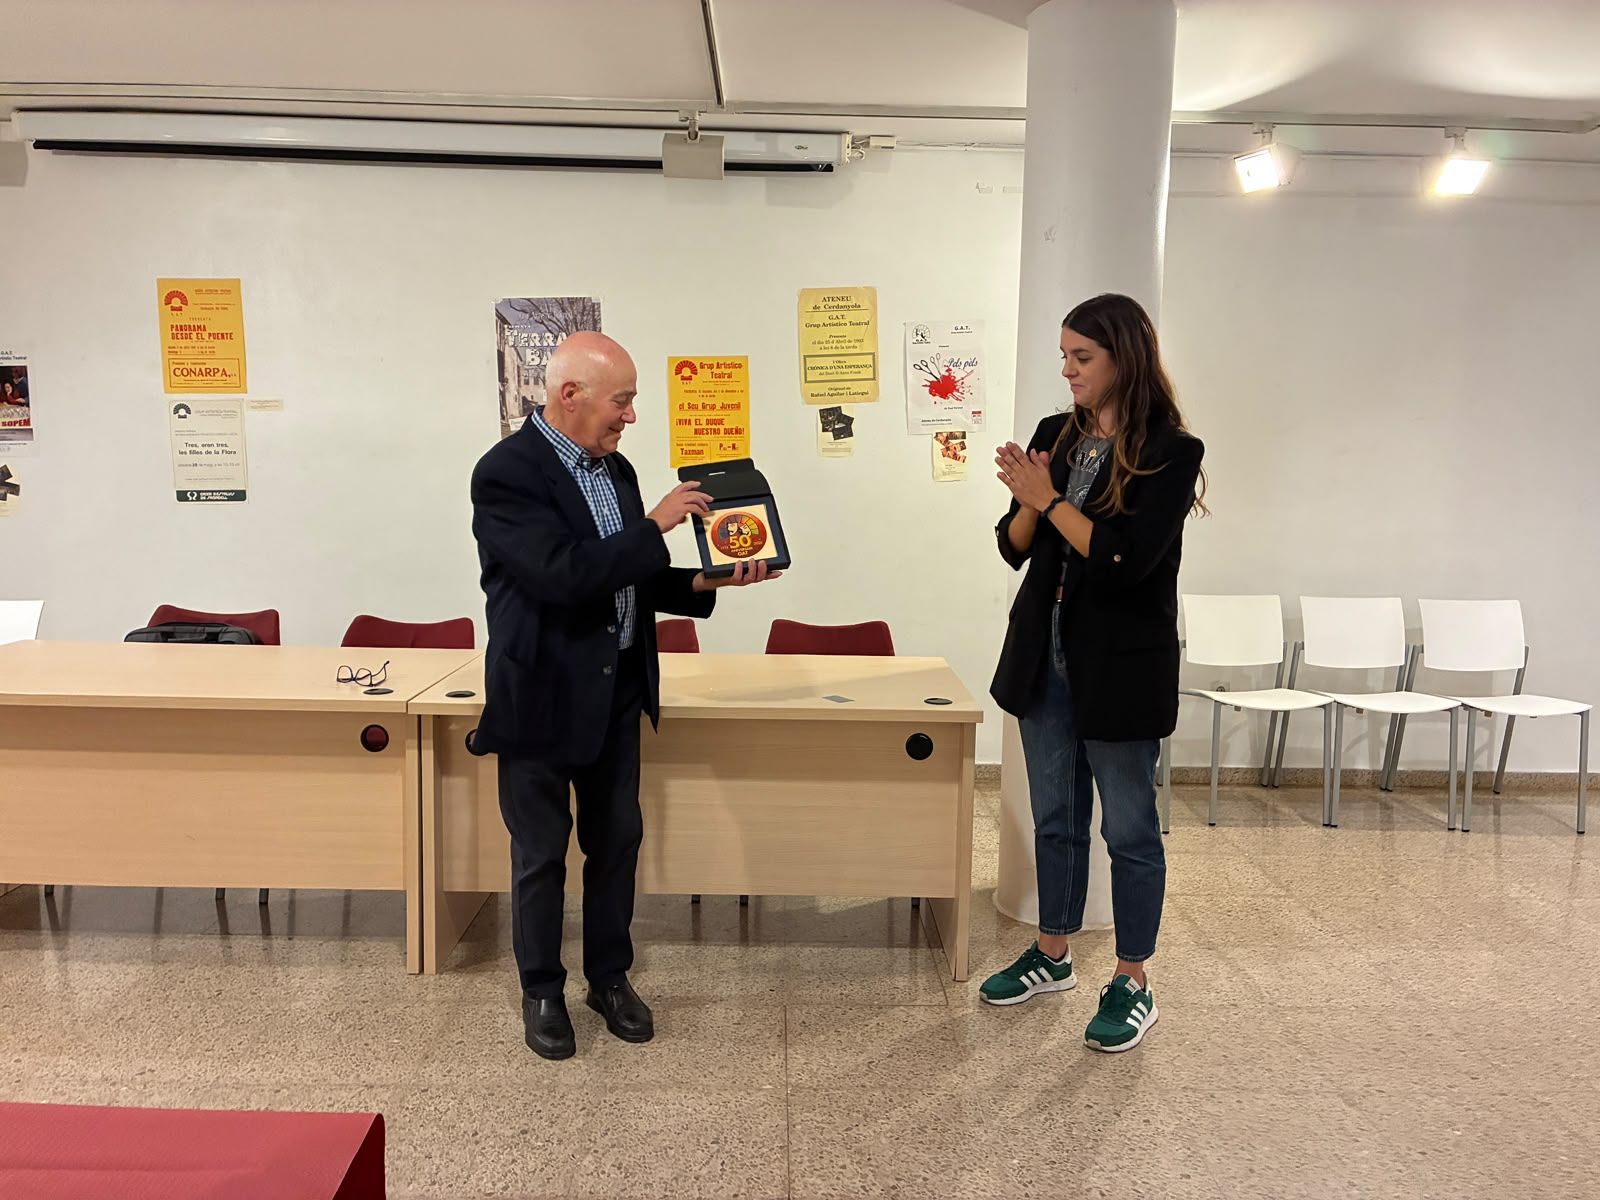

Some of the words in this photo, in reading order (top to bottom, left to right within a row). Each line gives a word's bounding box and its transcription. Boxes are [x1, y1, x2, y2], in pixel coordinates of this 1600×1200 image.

[170, 324, 207, 332] PANORAMA
[171, 332, 193, 340] DESDE
[196, 332, 205, 340] EL
[208, 332, 234, 340] PUENTE
[699, 362, 715, 370] Grup
[710, 371, 733, 379] Teatral
[702, 402, 717, 411] Grup
[720, 402, 741, 410] Juvenil
[695, 418, 703, 426] EL
[706, 418, 725, 426] DUQUE
[694, 427, 721, 436] NUESTRO
[729, 535, 752, 549] 50
